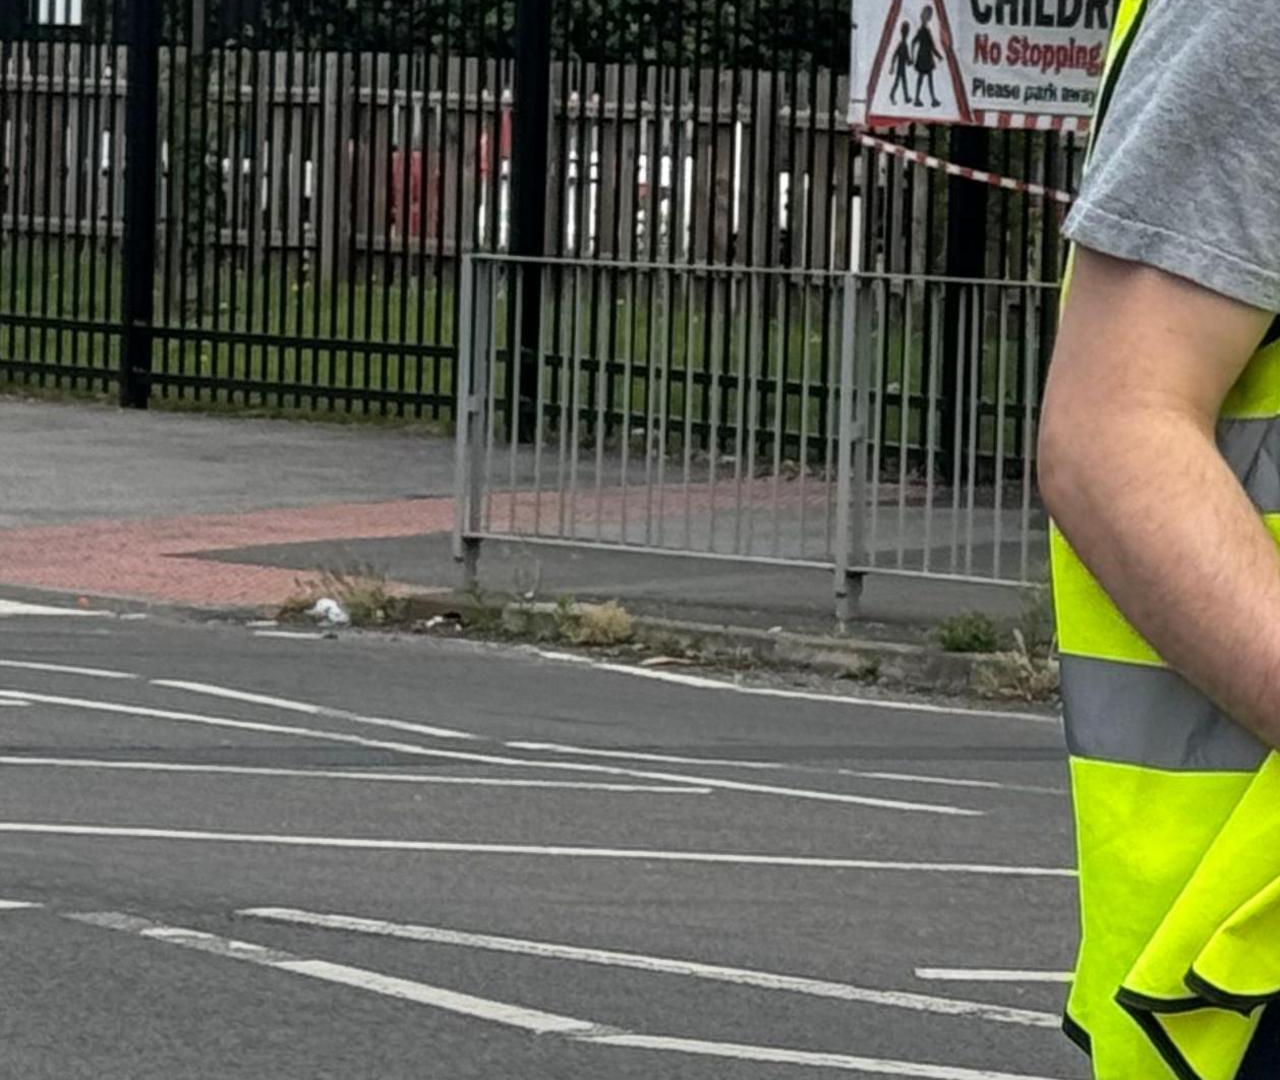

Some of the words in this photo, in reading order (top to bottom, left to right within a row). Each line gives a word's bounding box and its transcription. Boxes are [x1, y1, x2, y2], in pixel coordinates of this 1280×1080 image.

[973, 33, 1001, 65] No
[972, 77, 1020, 99] Please
[1024, 82, 1057, 104] park
